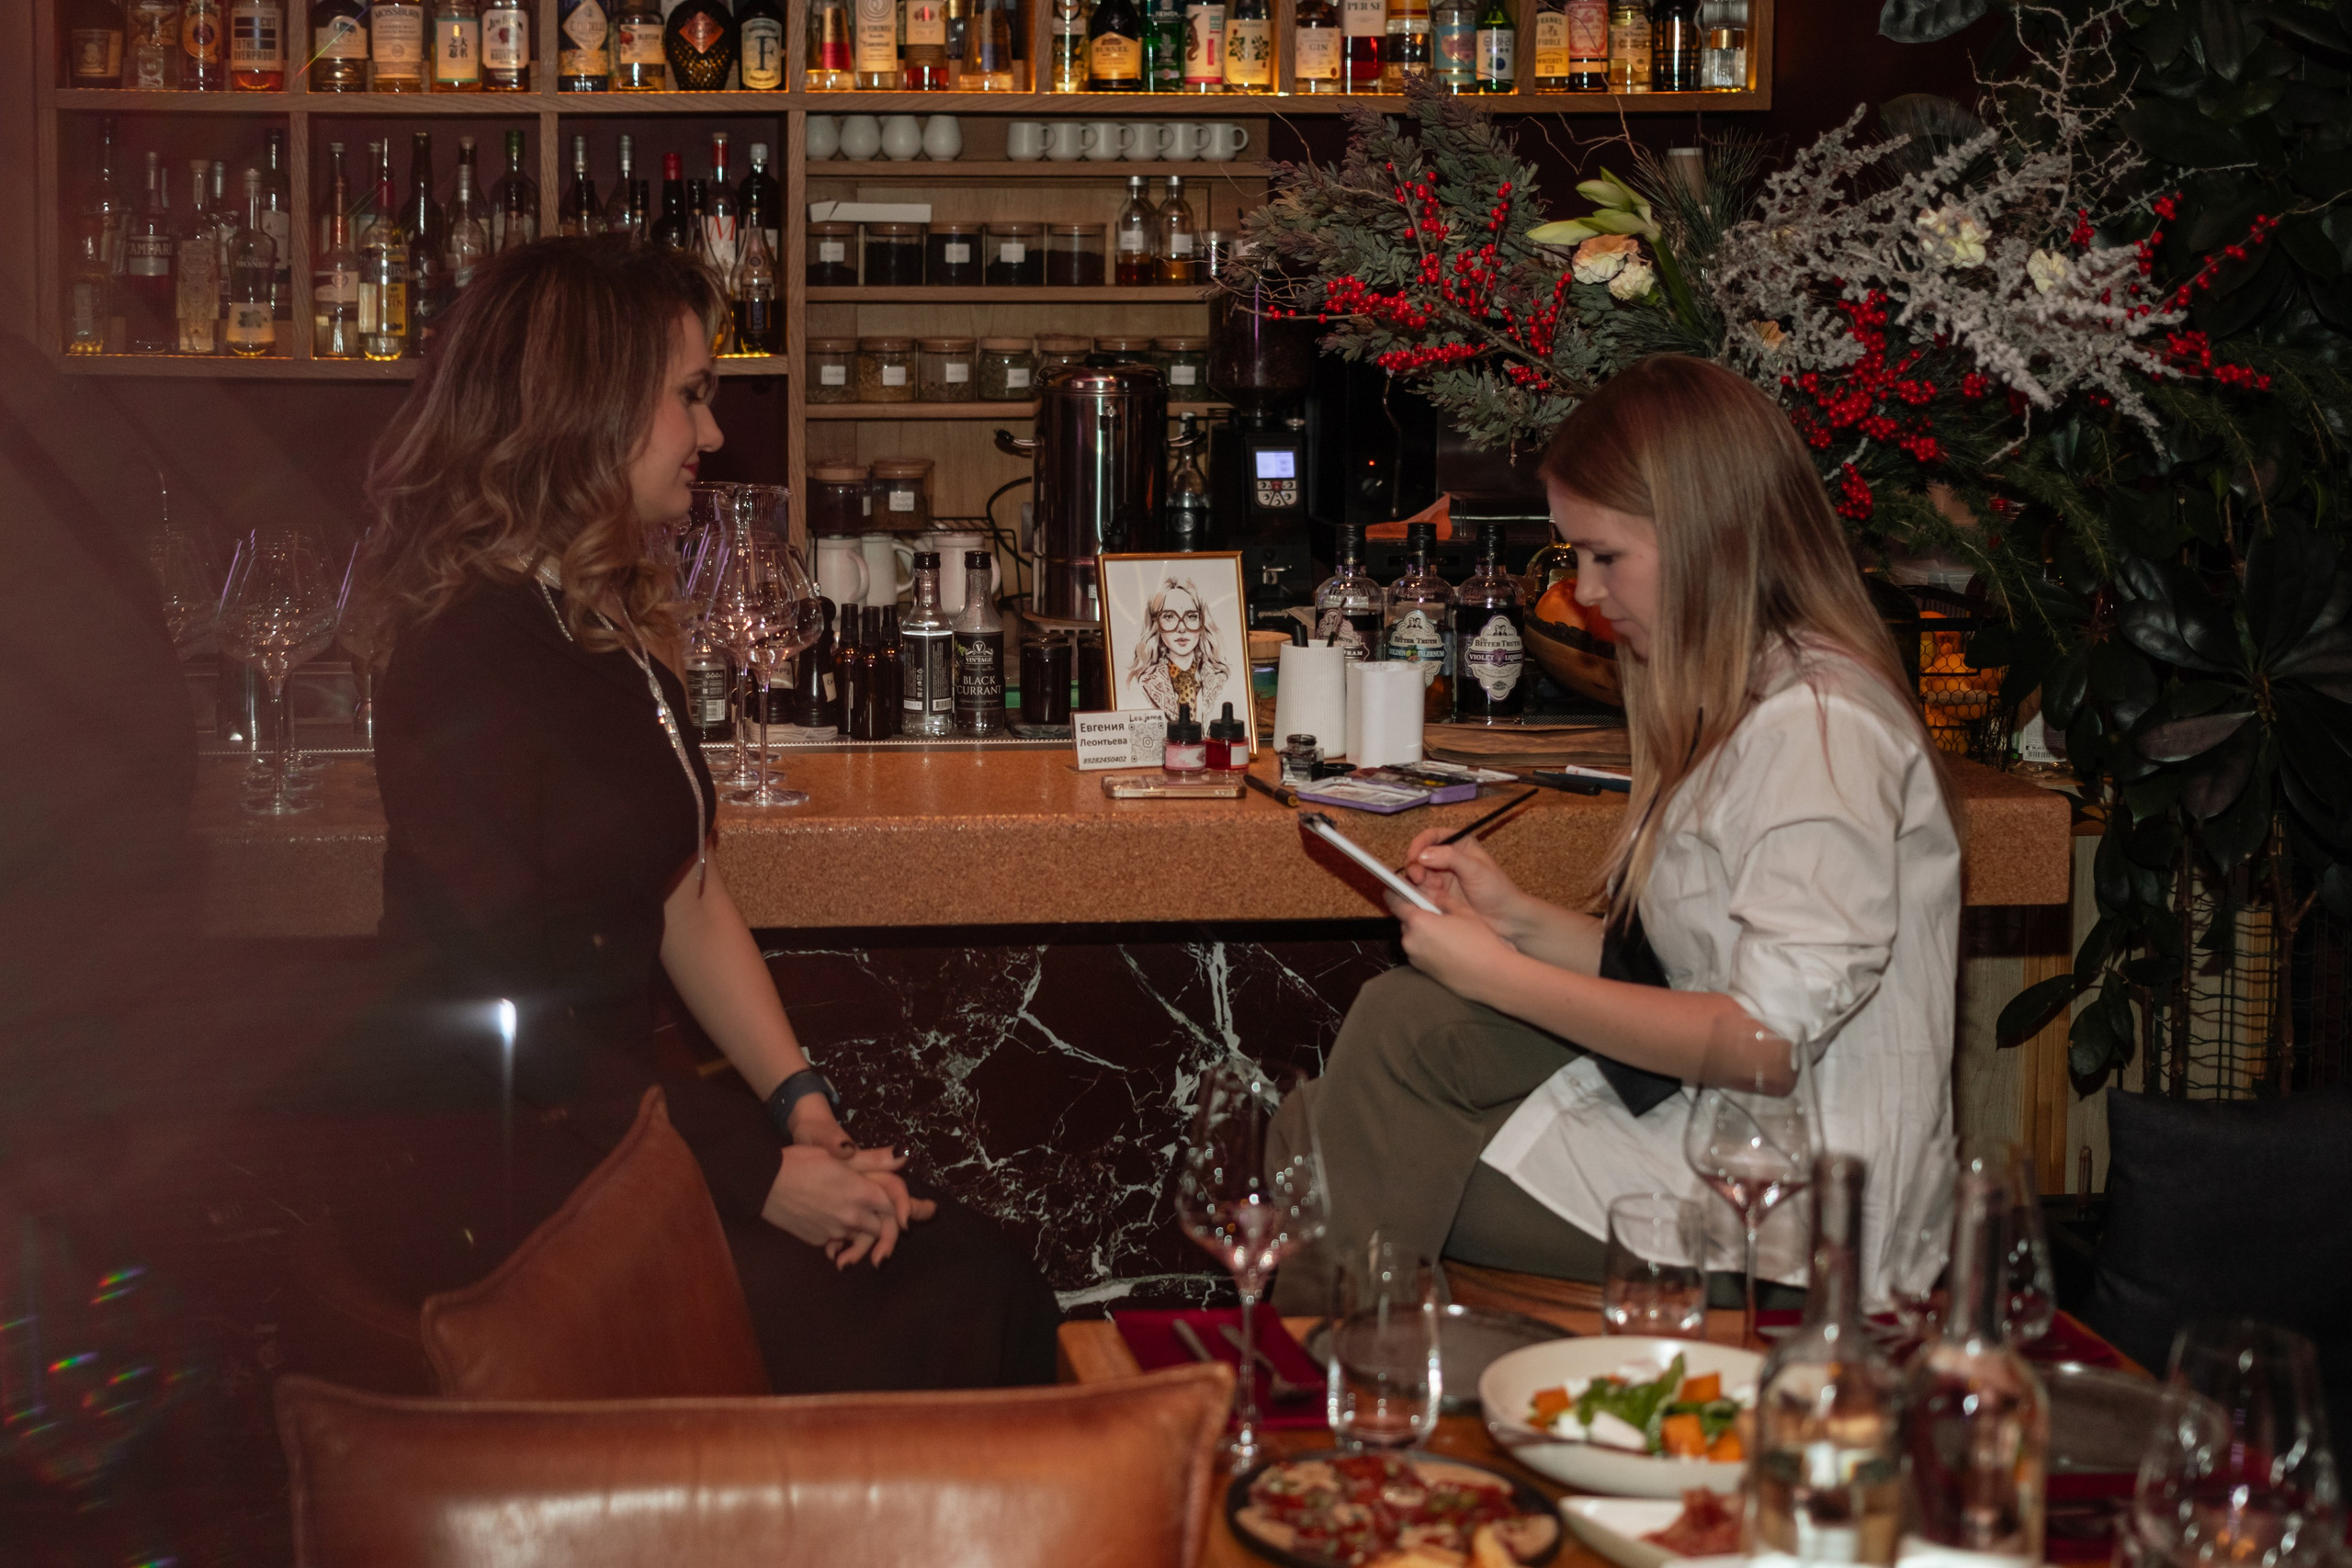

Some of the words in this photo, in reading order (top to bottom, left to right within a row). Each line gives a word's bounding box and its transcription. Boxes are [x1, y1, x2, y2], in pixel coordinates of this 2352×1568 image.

[1347, 1, 1369, 11] PER
[260, 17, 276, 28] CUT
[1537, 38, 1561, 46] FIDDLE
[234, 51, 277, 61] OVERPROOF
[754, 35, 780, 71] F
[1394, 636, 1414, 644] BITTER
[963, 675, 996, 685] BLACK
[956, 685, 1001, 695] CURRANT
[1080, 723, 1125, 732] Евгения
[1080, 738, 1128, 747] Леонтьева
[1083, 756, 1127, 764] 89282450402
